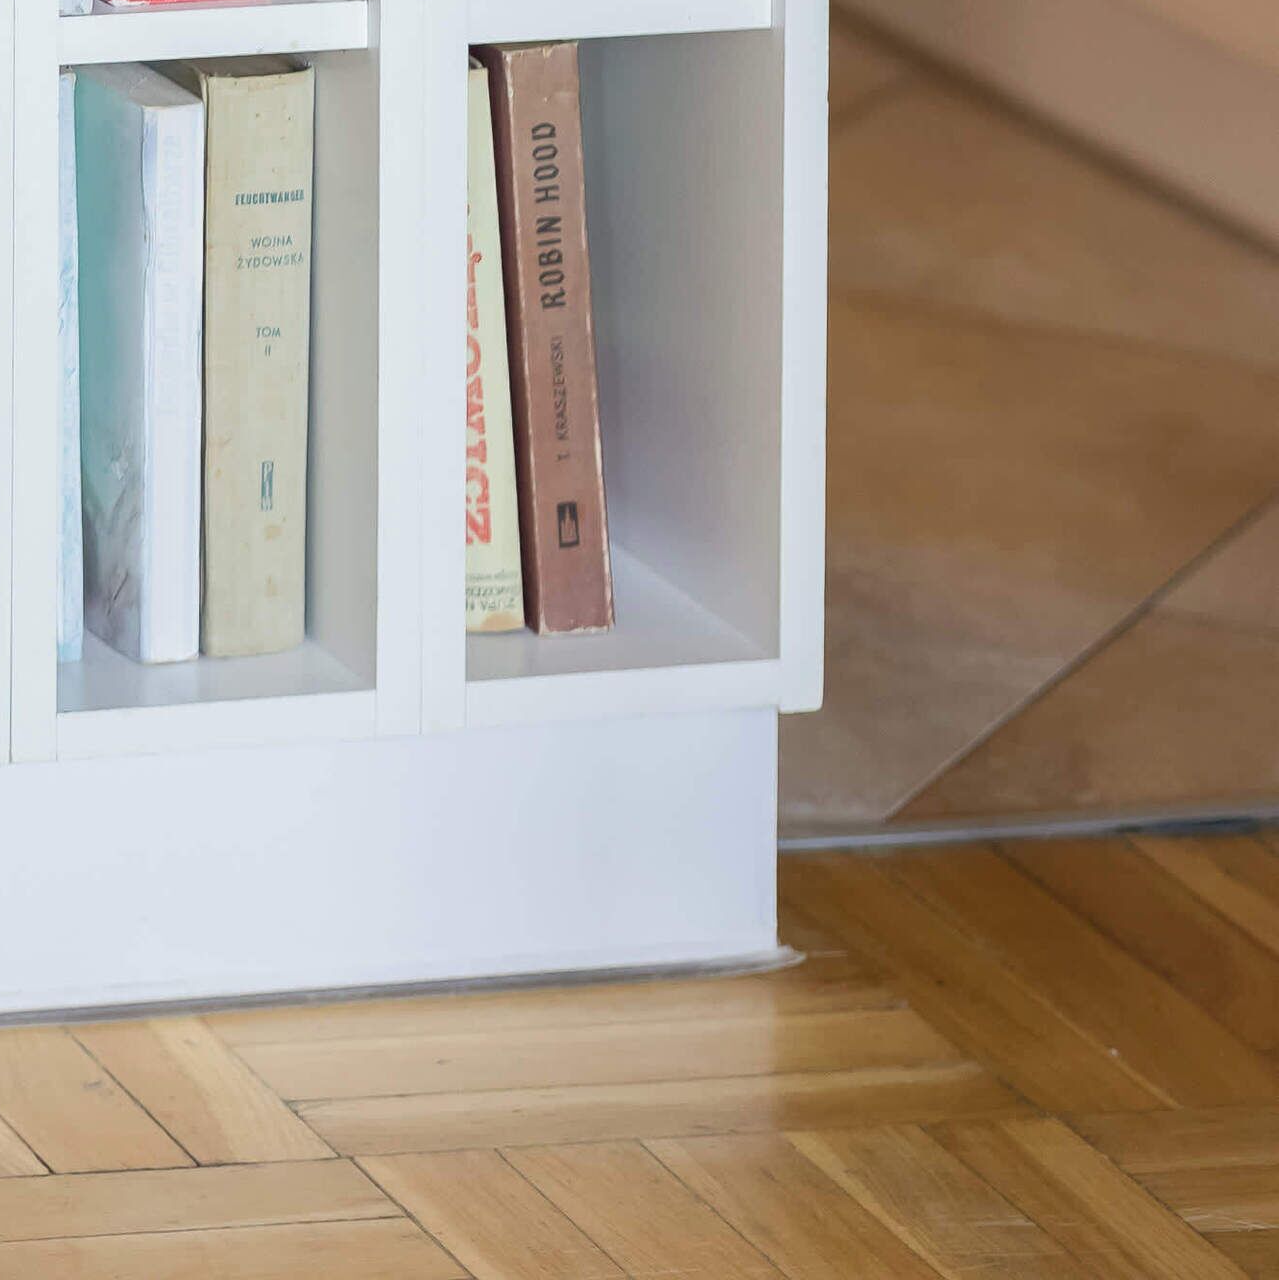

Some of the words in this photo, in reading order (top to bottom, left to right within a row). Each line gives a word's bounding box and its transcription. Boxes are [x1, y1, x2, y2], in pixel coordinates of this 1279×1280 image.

[531, 121, 560, 204] HOOD
[251, 235, 293, 249] WOJNA
[536, 216, 567, 310] ROBIN
[256, 326, 281, 338] TOM
[264, 344, 271, 357] II
[550, 335, 570, 441] KRASZEWSKI
